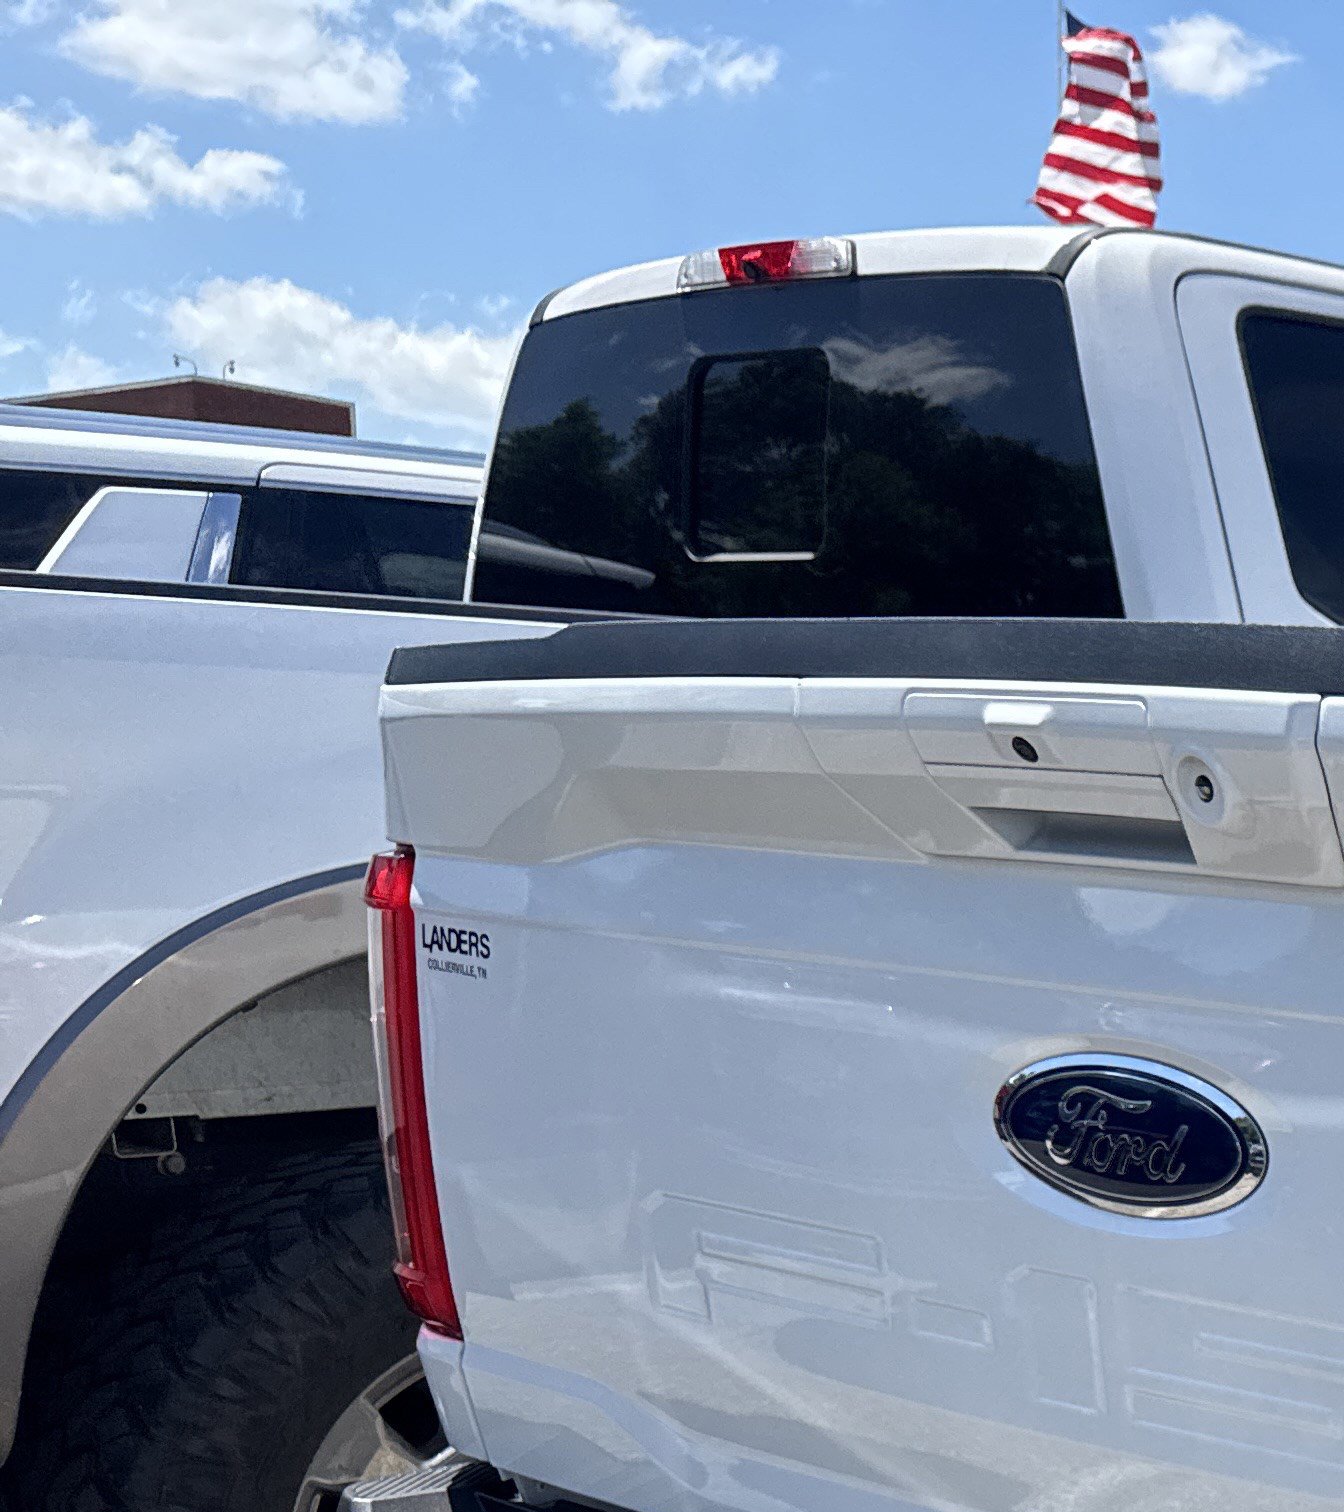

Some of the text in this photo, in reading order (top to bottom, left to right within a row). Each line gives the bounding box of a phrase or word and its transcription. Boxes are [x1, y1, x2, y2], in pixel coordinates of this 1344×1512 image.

[421, 923, 491, 959] LANDERS
[477, 965, 488, 980] TN
[1045, 1085, 1189, 1184] Ford
